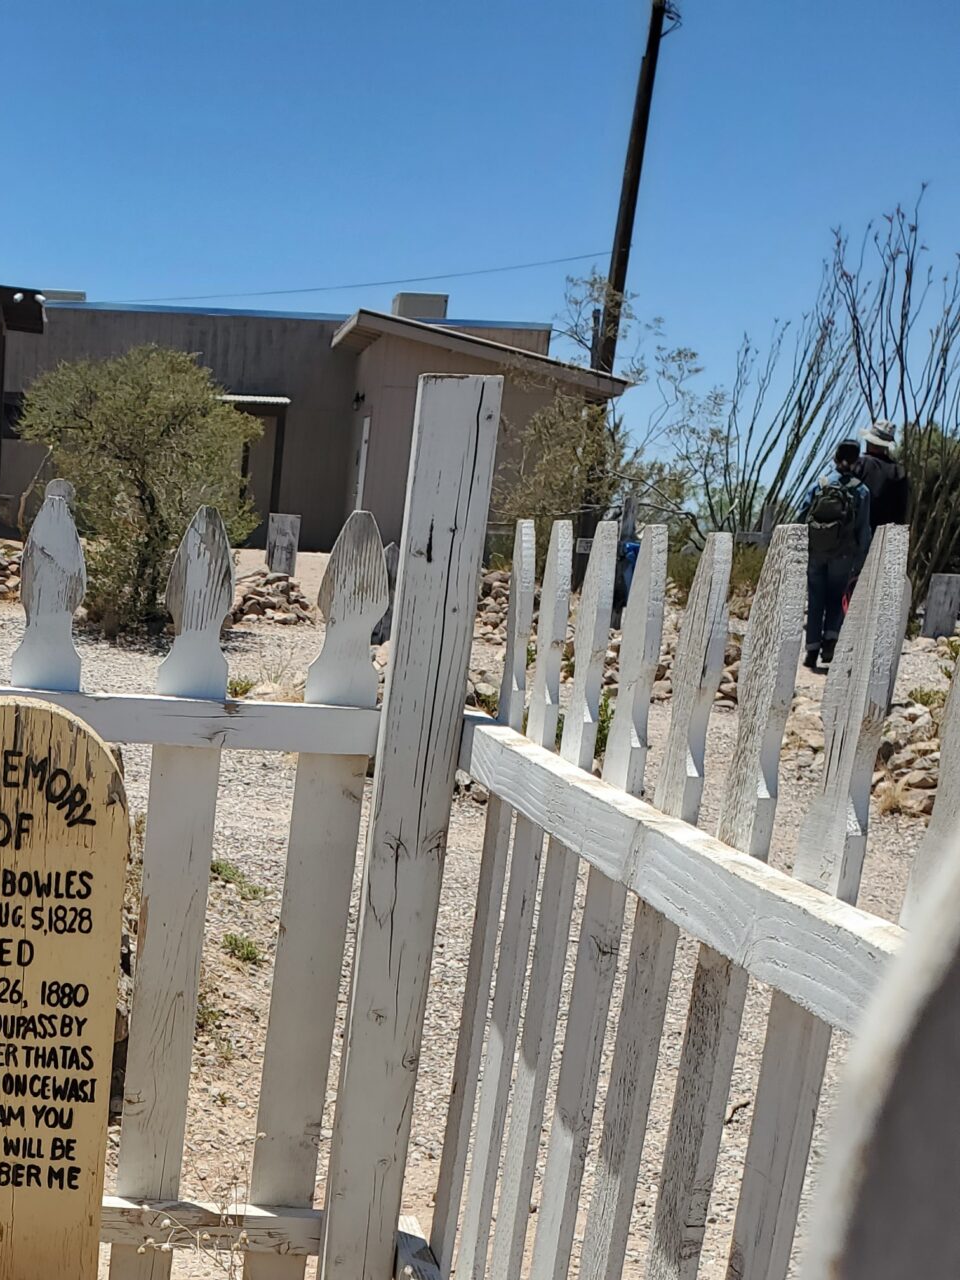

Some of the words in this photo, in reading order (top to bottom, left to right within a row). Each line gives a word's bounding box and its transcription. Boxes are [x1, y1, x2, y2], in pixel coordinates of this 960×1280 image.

[2, 868, 93, 899] BOWLES
[41, 981, 89, 1008] 1880
[60, 1013, 88, 1037] BY
[32, 1105, 74, 1130] YOU
[3, 1136, 44, 1159] WILL
[50, 1136, 77, 1161] BE
[47, 1165, 81, 1190] ME
